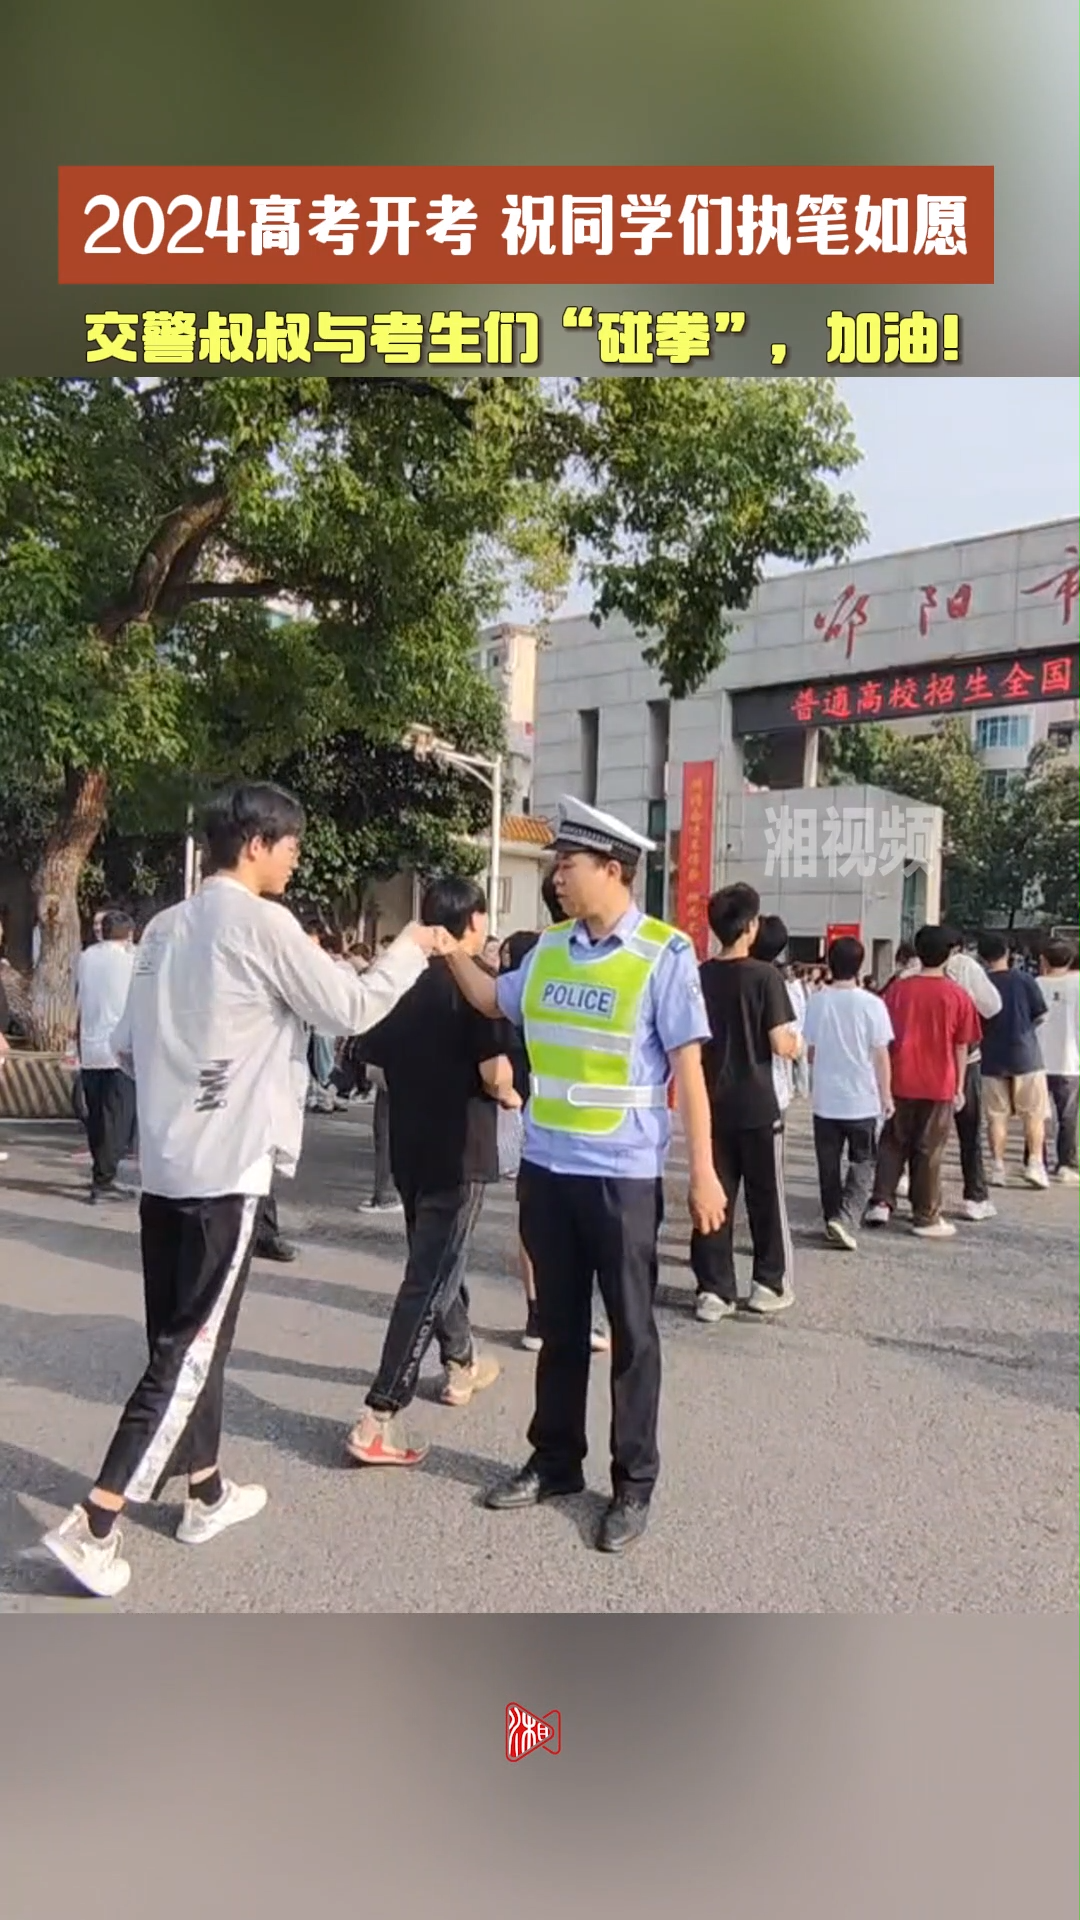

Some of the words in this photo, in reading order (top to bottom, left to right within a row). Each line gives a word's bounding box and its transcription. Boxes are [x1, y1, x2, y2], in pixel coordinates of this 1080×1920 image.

[791, 656, 1074, 721] 普通高校招生全国
[542, 983, 612, 1013] POLICE
